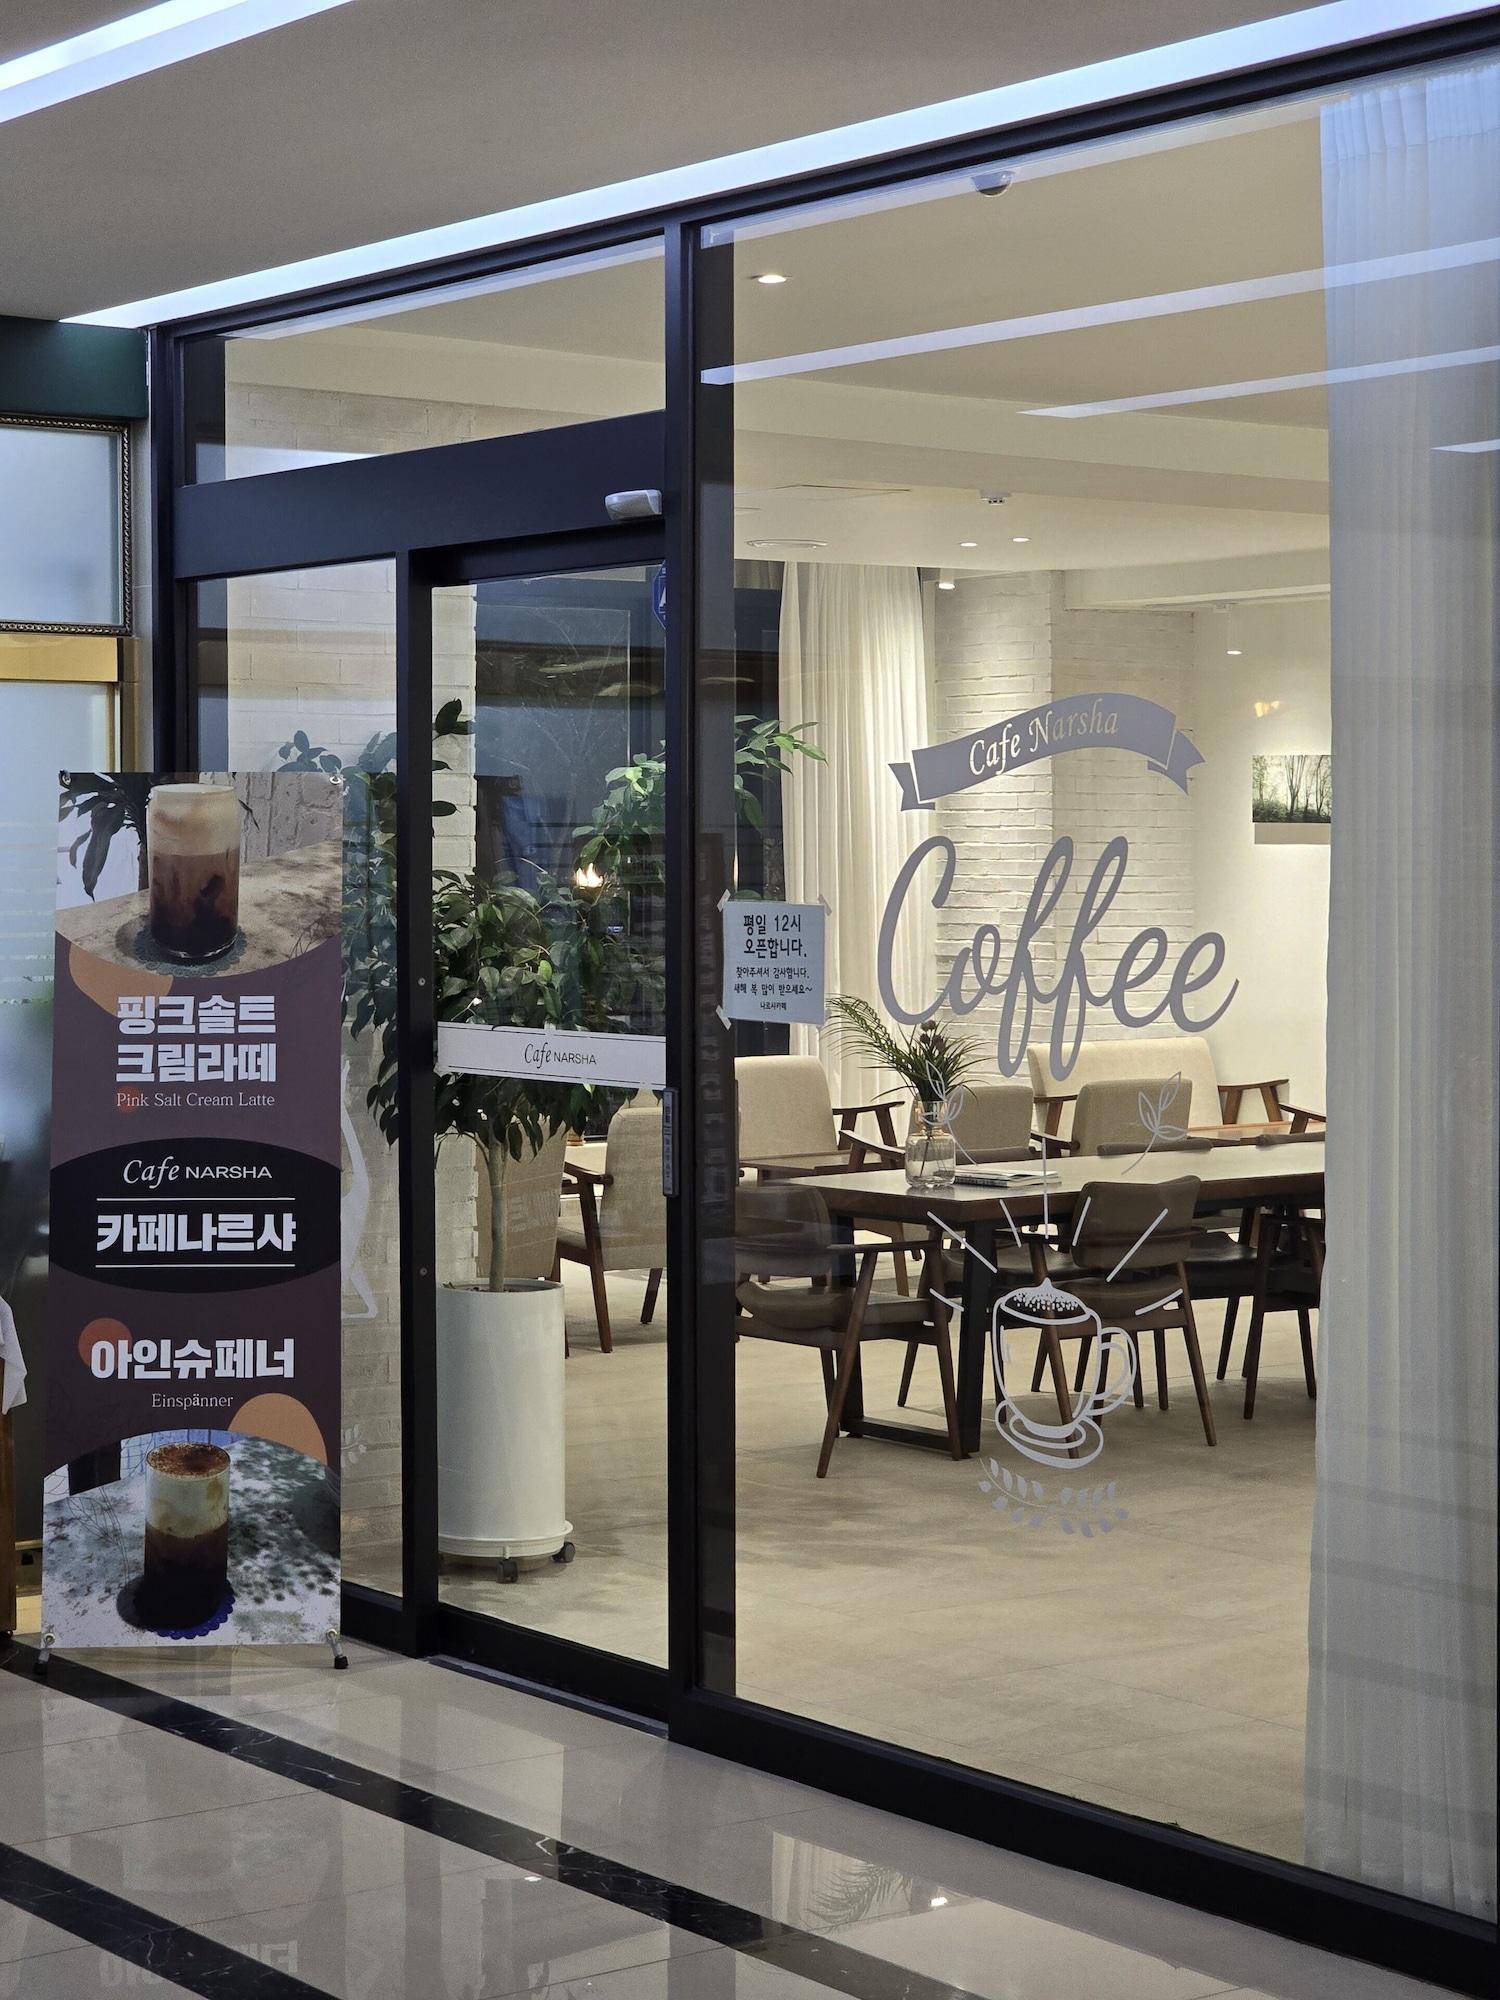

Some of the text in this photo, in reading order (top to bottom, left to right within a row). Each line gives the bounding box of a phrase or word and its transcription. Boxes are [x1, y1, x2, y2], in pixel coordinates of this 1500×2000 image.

[969, 698, 1119, 776] Cafe Narsha
[743, 914, 801, 936] 평일 12시
[743, 937, 807, 959] 오픈합니다.
[877, 835, 1240, 1082] Coffee
[736, 966, 810, 980] 찾아주셔서 감사합니다.
[734, 983, 747, 995] 새해
[761, 984, 775, 996] 많이
[778, 984, 813, 996] 받으세요~
[117, 995, 276, 1034] 핑크솔트
[116, 1043, 276, 1082] 크림라떼
[524, 1042, 597, 1069] Cafe NARSHA
[117, 1092, 275, 1107] Pink Salt Cream Latte
[123, 1156, 272, 1189] Cafe NARSHA
[96, 1213, 297, 1252] 카페나르샤
[90, 1338, 295, 1380] 아인슈페너
[151, 1393, 234, 1410] Einspänner
